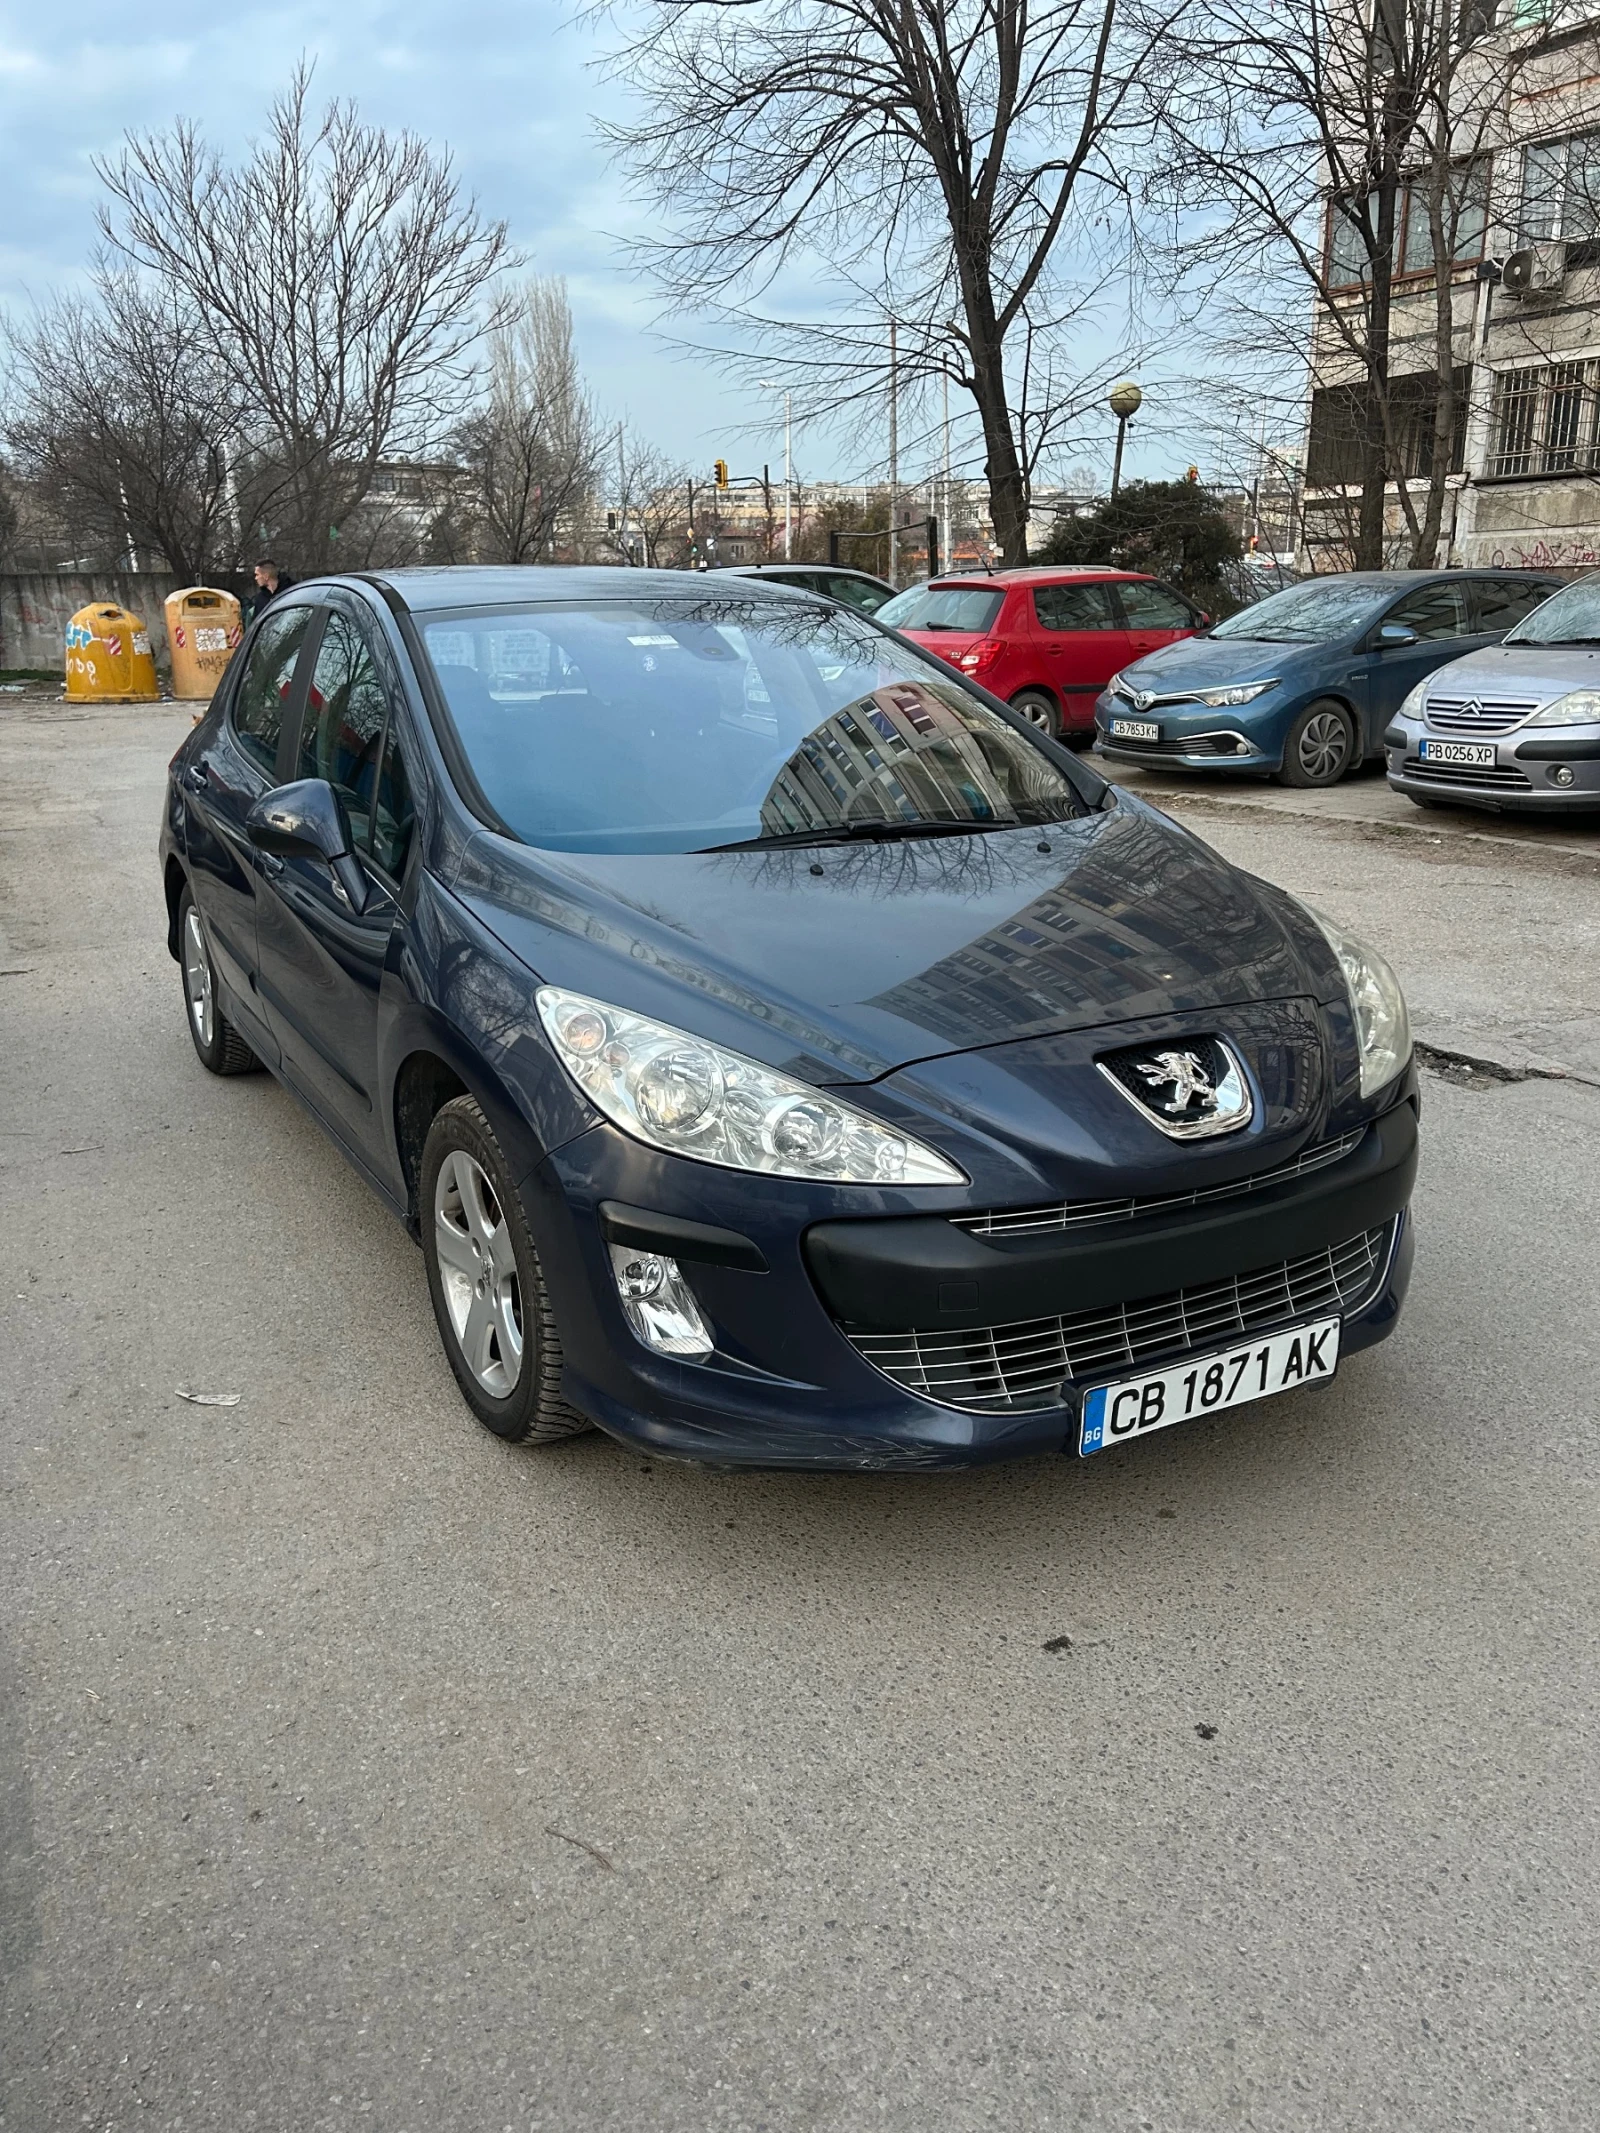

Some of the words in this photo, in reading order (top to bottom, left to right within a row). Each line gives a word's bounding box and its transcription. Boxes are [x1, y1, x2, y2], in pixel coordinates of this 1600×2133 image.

[1115, 722, 1125, 733] CB
[1126, 723, 1145, 736] 7853
[1146, 726, 1157, 738] KH
[1428, 744, 1443, 759] PB
[1445, 746, 1474, 761] 0256
[1476, 748, 1492, 763] XP
[1110, 1380, 1166, 1435] CB
[1183, 1346, 1270, 1414] 1871
[1281, 1327, 1331, 1385] AK
[1084, 1426, 1102, 1445] BG
